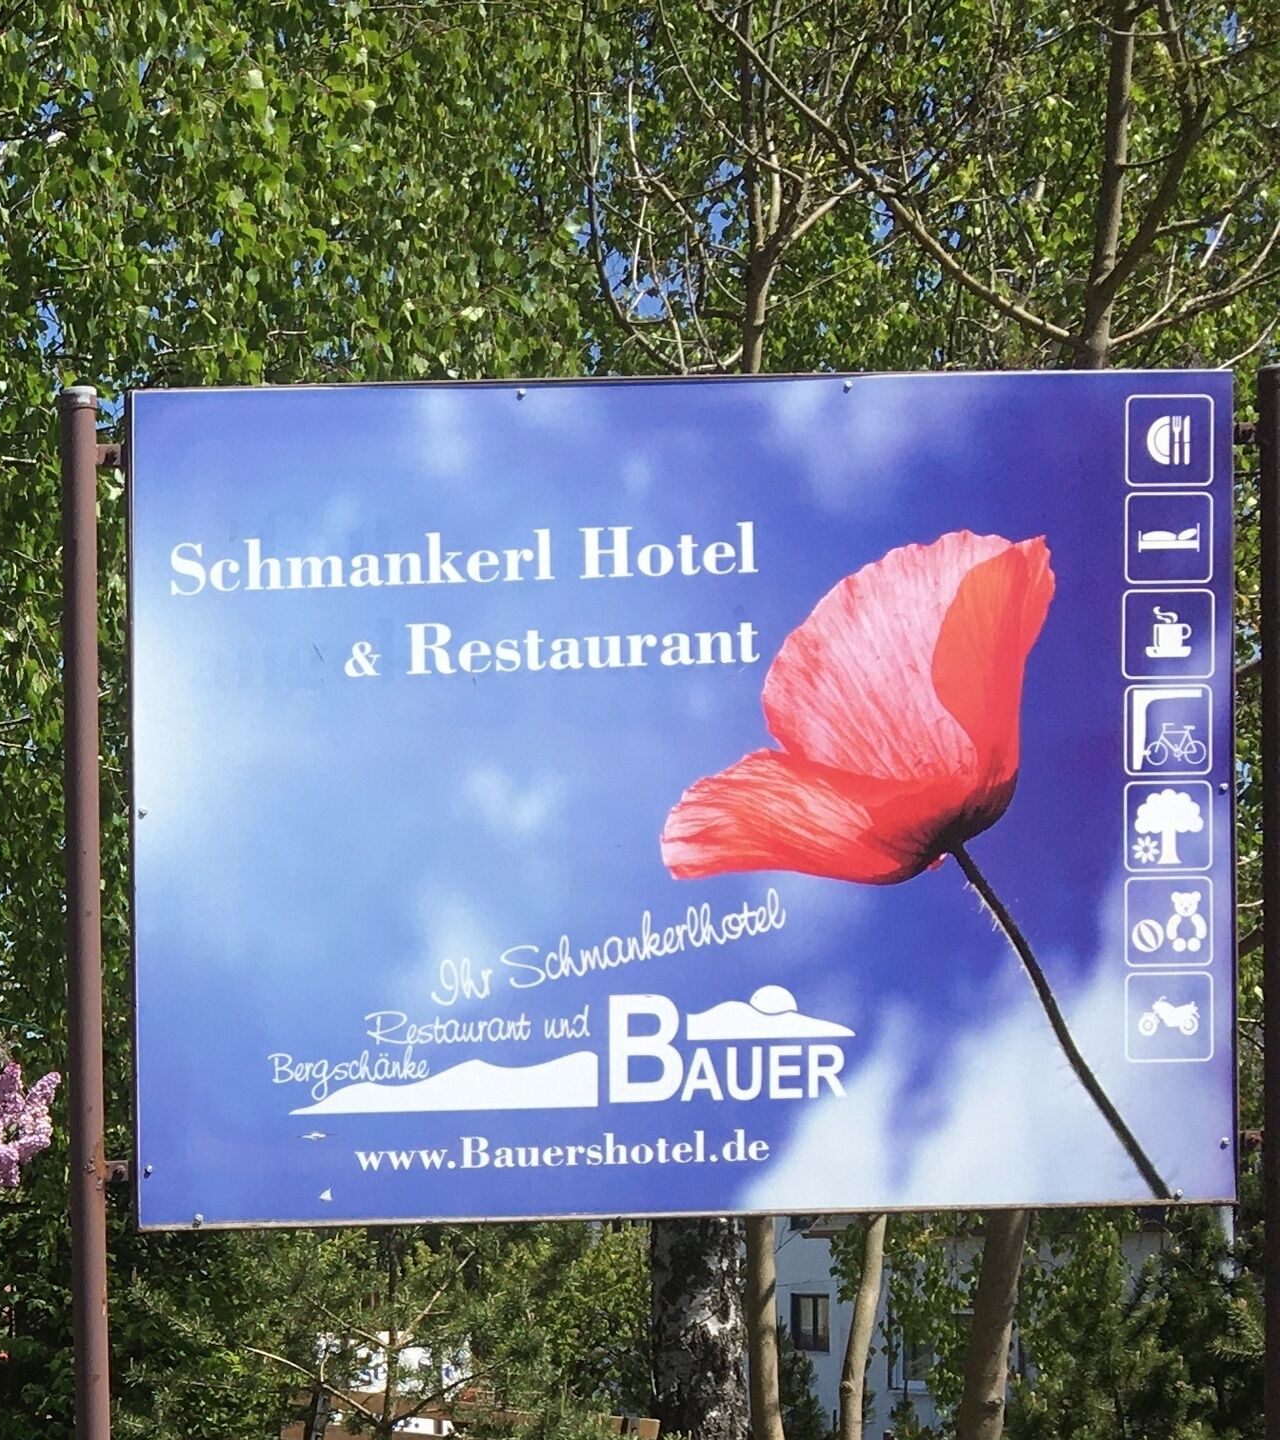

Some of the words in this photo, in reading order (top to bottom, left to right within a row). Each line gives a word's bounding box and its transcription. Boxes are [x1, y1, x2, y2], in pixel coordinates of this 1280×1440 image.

[169, 528, 556, 596] Schmankerl
[578, 521, 759, 580] Hotel
[344, 641, 382, 678] &
[405, 621, 760, 676] Restaurant
[430, 957, 494, 1006] Ihr
[500, 887, 787, 989] Schmankerlhotel
[363, 1010, 532, 1045] Restaurant
[543, 1005, 591, 1040] und
[608, 993, 848, 1104] BAUER
[268, 1045, 431, 1101] Bergschänke
[354, 1129, 770, 1172] www.Bauershotel.de
